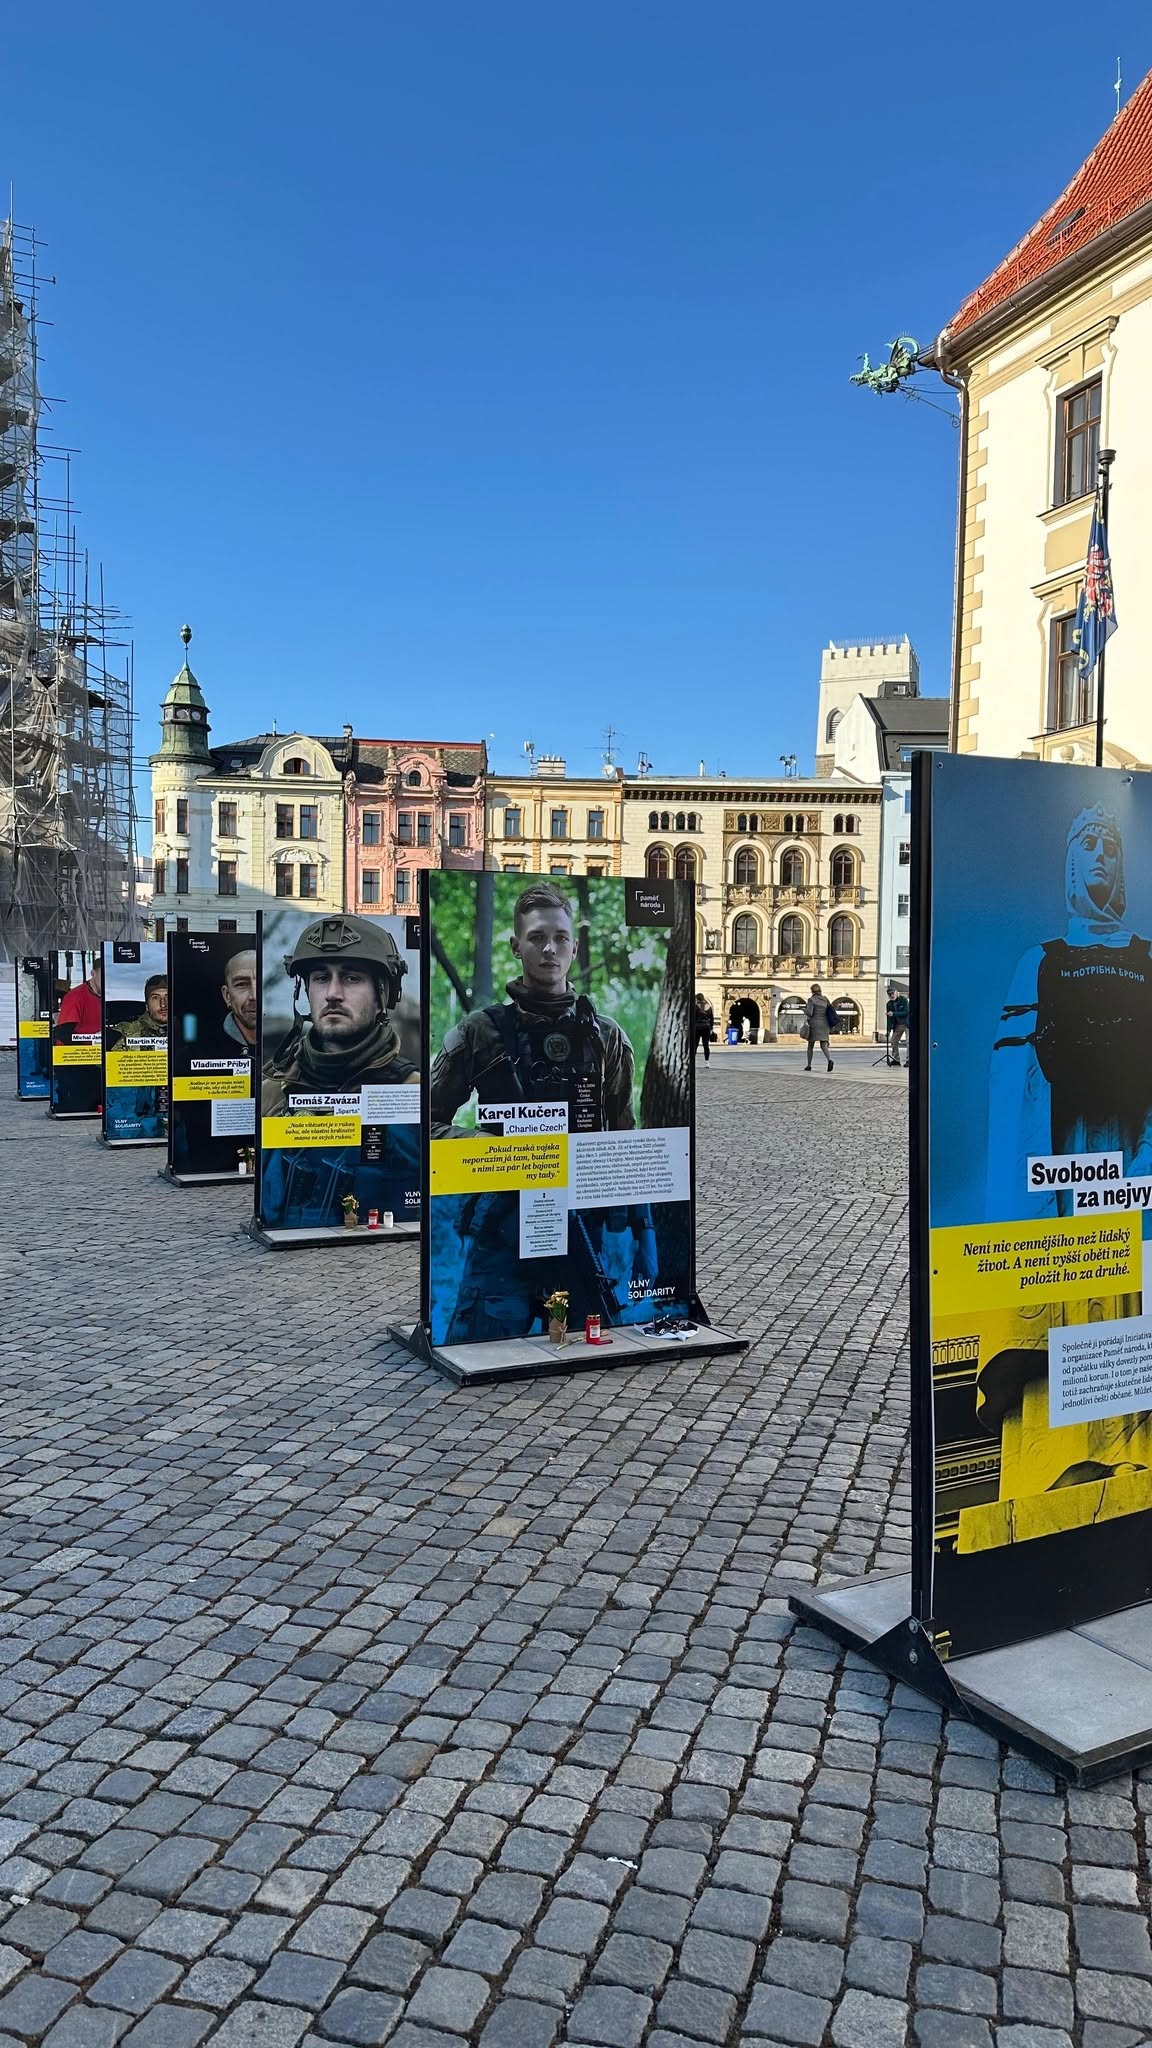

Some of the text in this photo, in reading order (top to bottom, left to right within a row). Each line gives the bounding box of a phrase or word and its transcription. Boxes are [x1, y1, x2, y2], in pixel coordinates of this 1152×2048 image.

[291, 1096, 360, 1105] Tomáš Zavázal
[478, 1105, 566, 1120] Karel Kučera
[506, 1124, 566, 1134] „Charlie Czech“
[485, 1145, 512, 1154] „Pokud
[536, 1142, 560, 1152] vojska
[462, 1156, 503, 1165] neporazím
[504, 1154, 512, 1163] já
[532, 1152, 560, 1160] budeme
[478, 1164, 495, 1172] nimi
[506, 1164, 520, 1173] pár
[532, 1162, 560, 1171] bojovat
[1032, 1159, 1120, 1186] Svoboda
[1077, 1182, 1152, 1209] za nejvy
[963, 1228, 1130, 1256] Není nic cennějšího než lidský
[977, 1244, 1130, 1272] život. A není vyšší oběti než
[628, 1279, 650, 1288] VLNY
[1020, 1262, 1130, 1290] položit ho za druhé.
[628, 1286, 676, 1299] SOLIDARITY
[1062, 1340, 1092, 1353] Společně
[1099, 1335, 1124, 1348] pořádají
[1125, 1332, 1152, 1342] Iniciativa
[1067, 1352, 1102, 1363] organizace
[1104, 1346, 1123, 1357] Paměť
[1124, 1343, 1146, 1354] národa,
[1062, 1366, 1071, 1374] od
[1072, 1362, 1098, 1375] počátku
[1062, 1374, 1088, 1386] milionů
[1132, 1367, 1138, 1376] je
[1062, 1387, 1078, 1397] totiž
[1079, 1382, 1114, 1394] zachraňuje
[1114, 1377, 1141, 1388] skutečné
[1061, 1396, 1093, 1410] jednotliví
